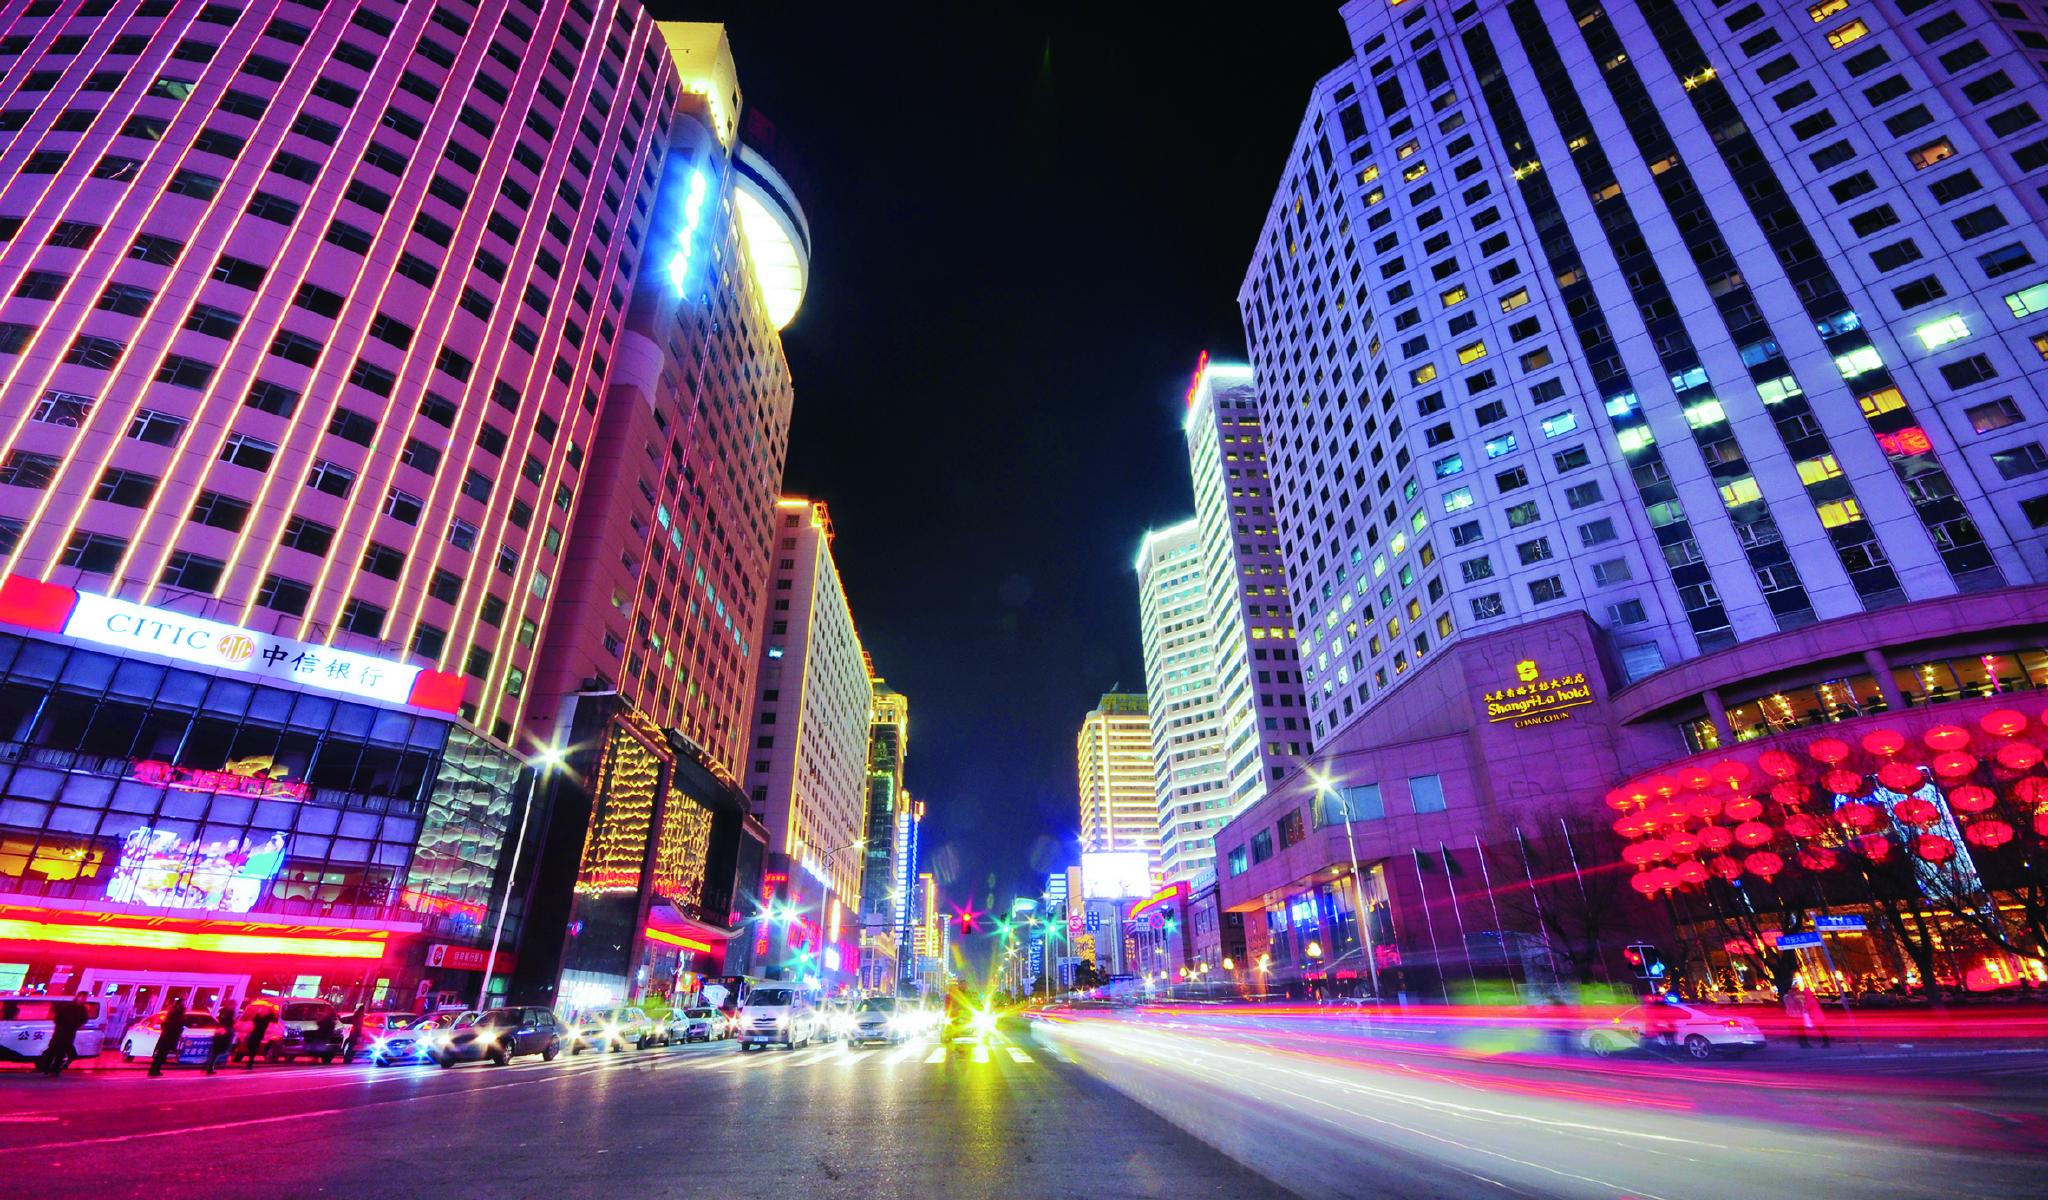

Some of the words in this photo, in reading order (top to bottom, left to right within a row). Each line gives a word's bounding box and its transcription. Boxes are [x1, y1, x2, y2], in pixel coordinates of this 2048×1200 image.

[106, 613, 210, 650] CITIC
[262, 644, 384, 687] 中信银行
[1488, 694, 1555, 716] Shangri-La
[1514, 711, 1570, 729] CHANGCHUN
[17, 1030, 46, 1041] 公安
